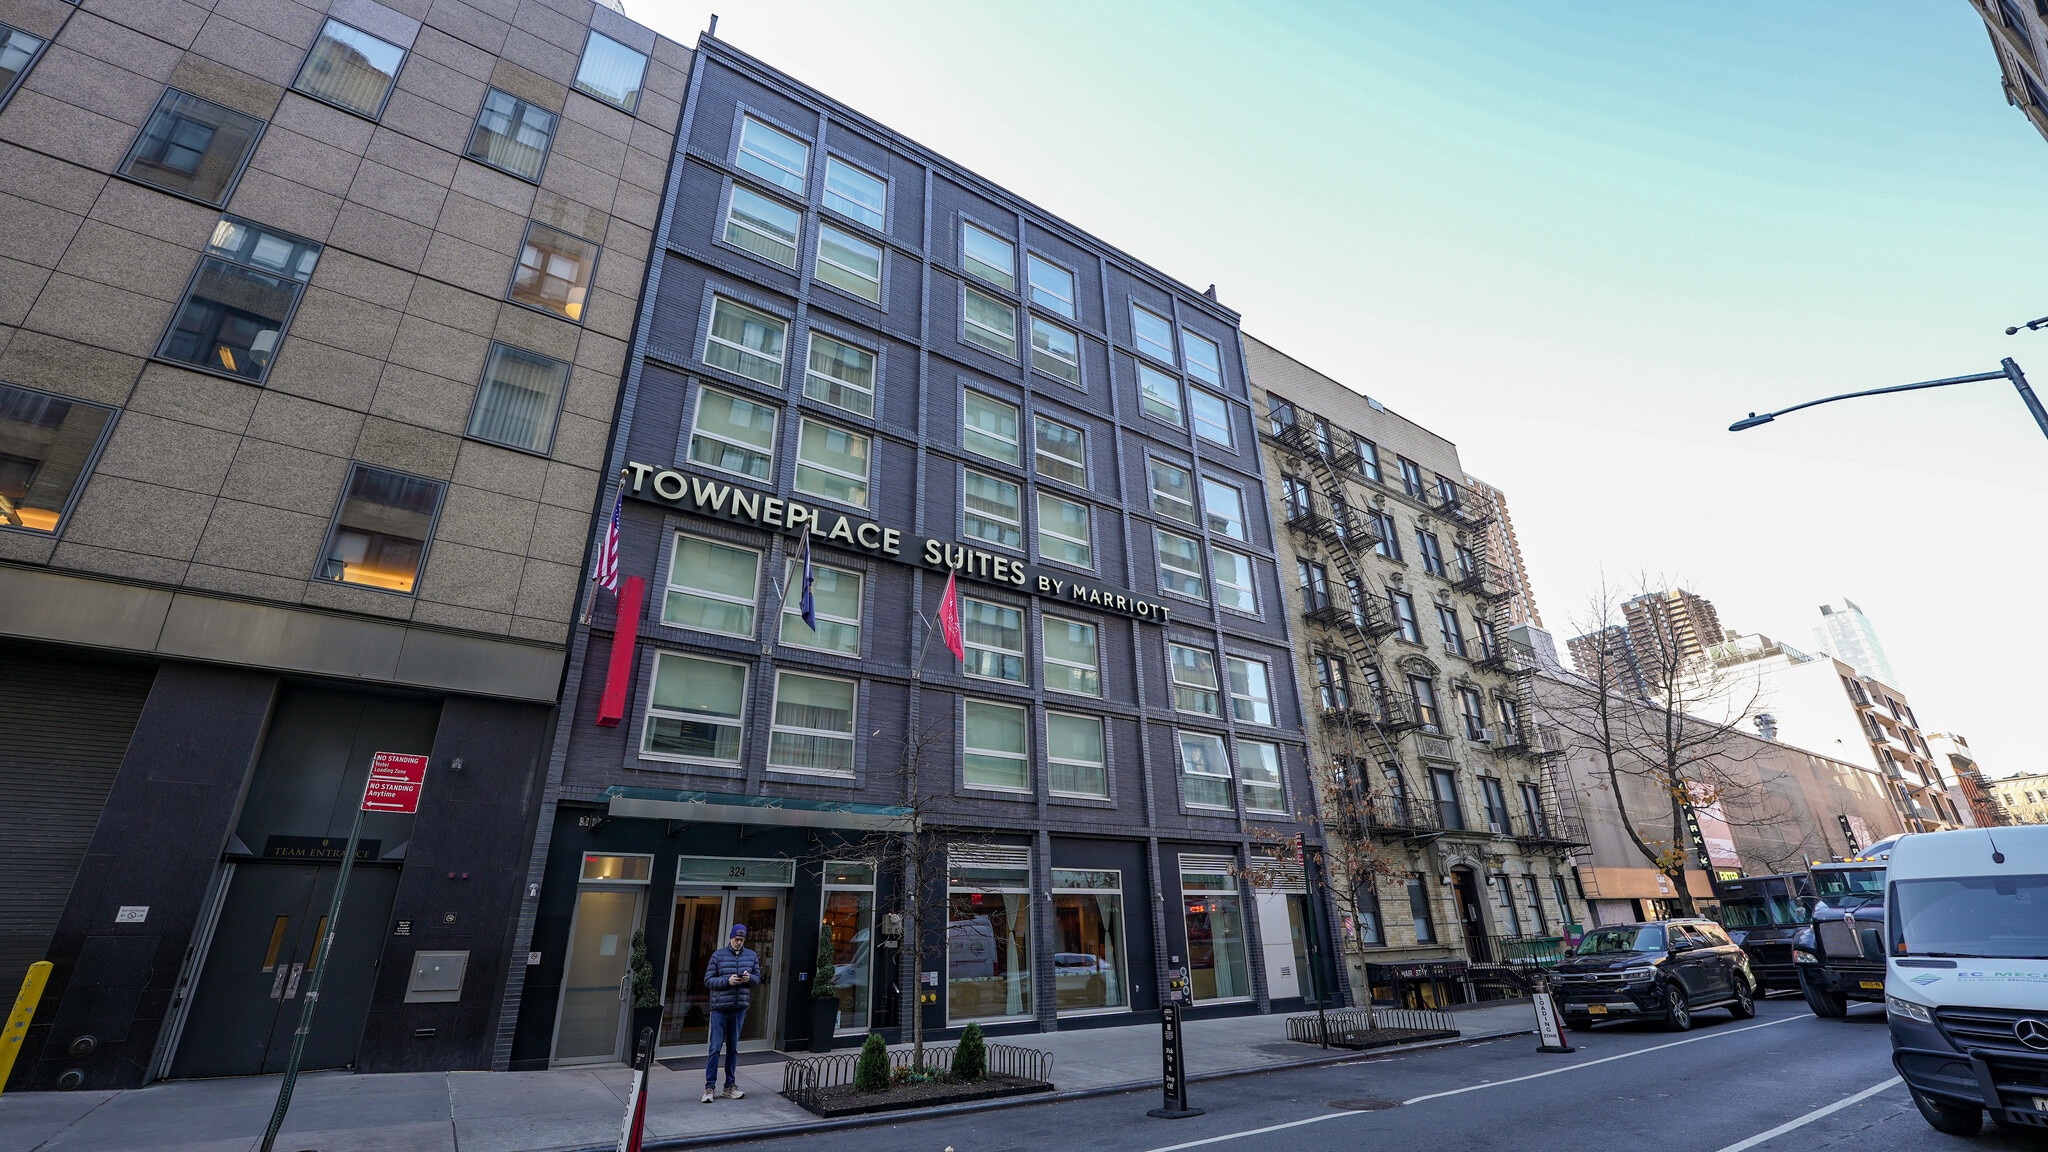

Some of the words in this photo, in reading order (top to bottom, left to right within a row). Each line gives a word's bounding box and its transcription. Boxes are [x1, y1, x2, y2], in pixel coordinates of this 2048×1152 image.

[628, 461, 900, 555] TOWNEPLACE
[924, 539, 1026, 585] SUITES
[1038, 575, 1064, 594] BY
[1073, 583, 1171, 621] MARRIOTT
[388, 756, 419, 764] STANDING
[381, 784, 414, 792] STANDING
[275, 848, 305, 856] TEAM
[310, 848, 370, 858] ENTRACE
[728, 866, 746, 877] 324
[1538, 995, 1552, 1033] LOADING
